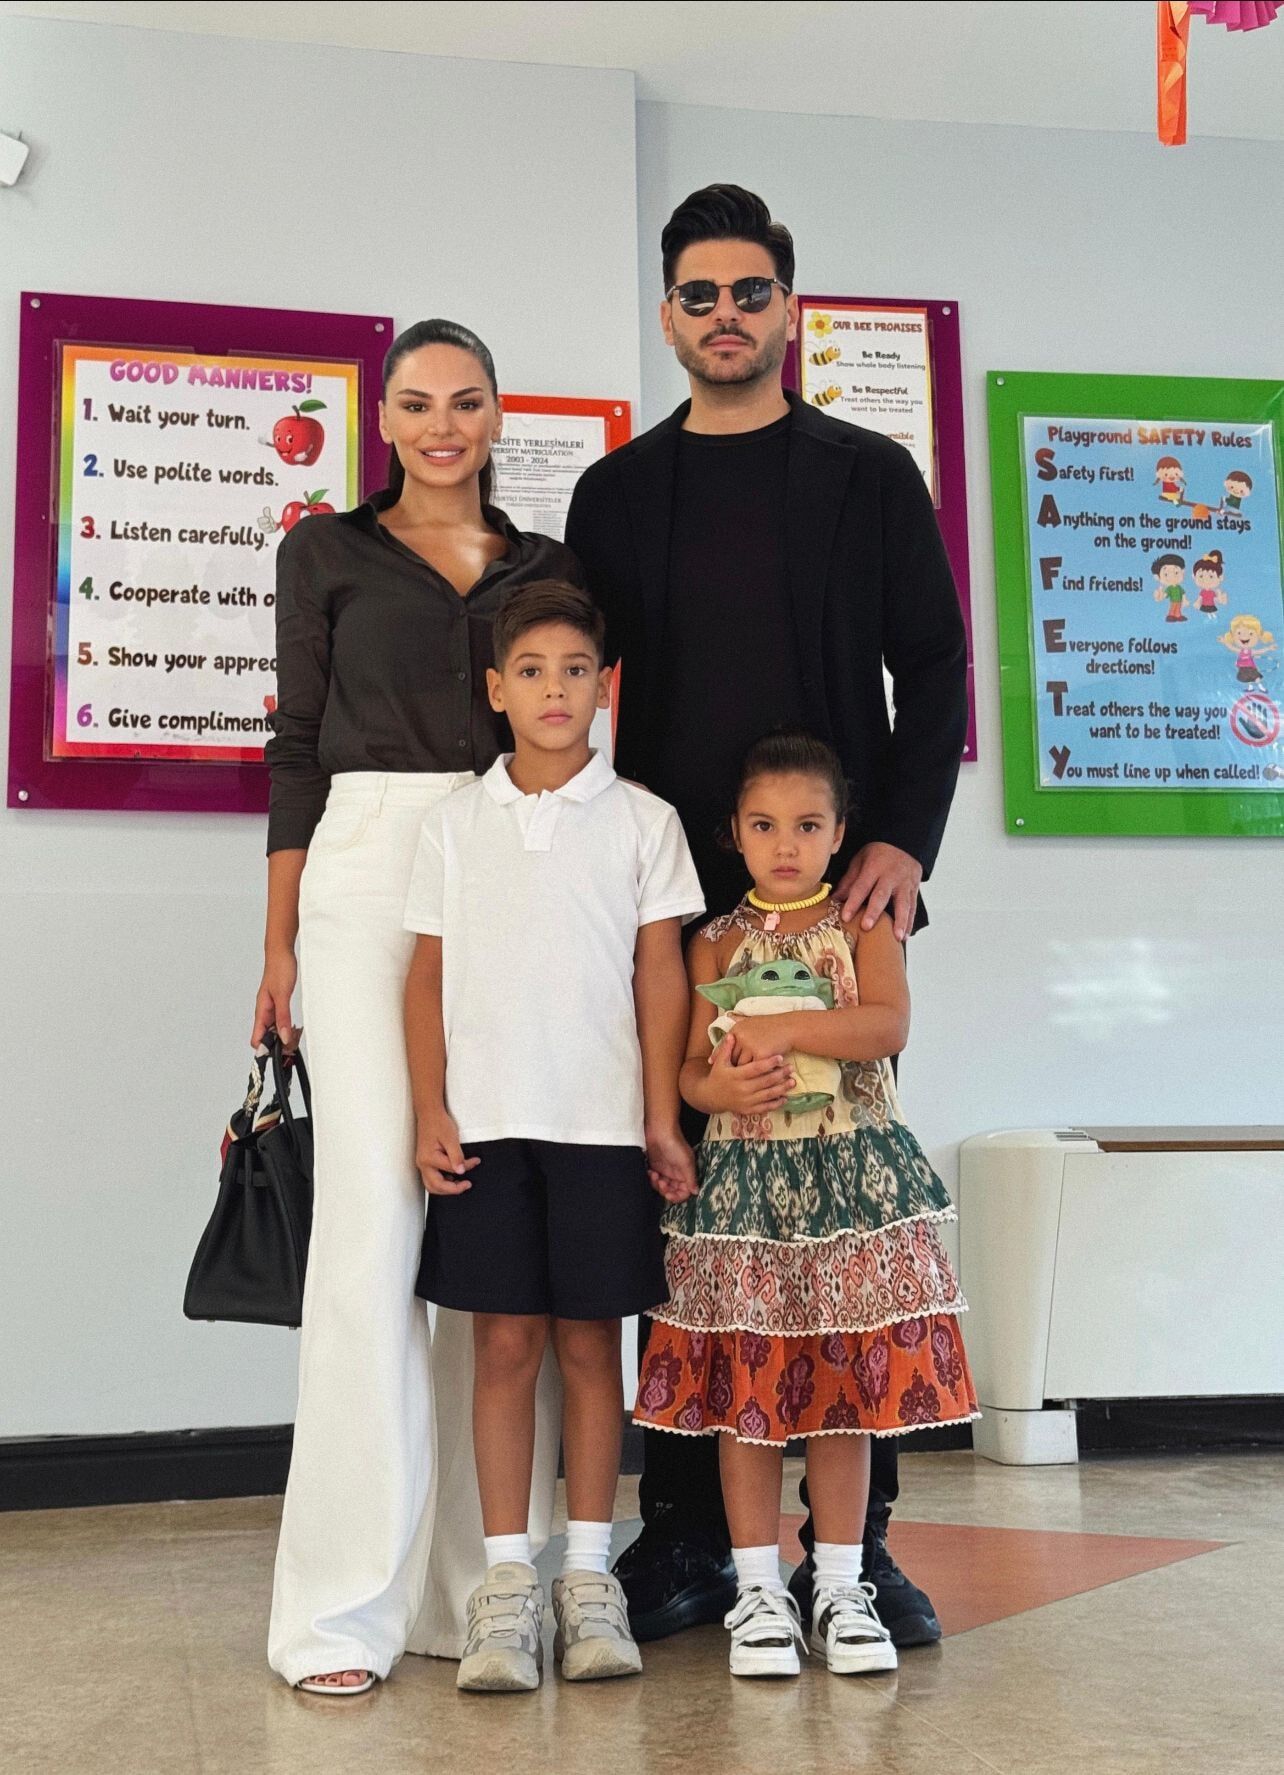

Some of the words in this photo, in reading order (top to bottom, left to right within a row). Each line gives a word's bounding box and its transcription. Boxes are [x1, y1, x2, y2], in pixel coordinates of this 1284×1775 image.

[833, 321, 850, 330] OUR
[854, 322, 871, 331] BEE
[875, 323, 922, 333] PROMISES
[862, 351, 873, 359] Be
[875, 351, 901, 361] Ready
[110, 359, 179, 384] GOOD
[188, 363, 312, 393] MANNERS!
[878, 362, 895, 370] body
[897, 363, 925, 371] listening
[865, 386, 908, 396] Respectful
[895, 398, 908, 406] way
[83, 398, 97, 421] 1.
[108, 403, 151, 424] Wait
[158, 412, 200, 429] your
[207, 408, 250, 430] turn.
[1047, 426, 1132, 447] Playground
[1137, 427, 1205, 446] SAFETY
[1212, 432, 1252, 448] Rules
[83, 454, 104, 477] 2.
[113, 459, 148, 478] Use
[154, 461, 211, 484] polite
[219, 466, 279, 486] words.
[1100, 466, 1134, 481] first!
[80, 516, 101, 539] 3.
[110, 520, 171, 542] Listen
[178, 525, 269, 551] carefully.
[1119, 517, 1135, 528] on
[1139, 514, 1160, 529] the
[1165, 516, 1212, 532] ground
[1216, 516, 1251, 534] stays
[1094, 535, 1111, 548] on
[1115, 533, 1136, 548] the
[1141, 535, 1192, 552] ground!
[78, 576, 100, 600] 4.
[109, 581, 210, 607] Cooperate
[218, 587, 256, 607] with
[1089, 577, 1143, 592] friends!
[1128, 638, 1177, 654] follows
[77, 642, 98, 665] 5.
[108, 647, 157, 668] Show
[165, 653, 207, 673] your
[76, 704, 99, 728] 6.
[108, 708, 151, 729] Give
[1100, 703, 1144, 718] others
[1148, 703, 1170, 718] the
[1175, 706, 1200, 721] way
[1204, 708, 1227, 721] you
[1090, 723, 1121, 738] want
[1126, 724, 1139, 738] to
[1144, 724, 1161, 739] be
[1165, 724, 1220, 740] treated!
[1087, 764, 1119, 779] must
[1123, 764, 1150, 779] line
[1155, 767, 1171, 782] up
[1176, 764, 1210, 780] when
[1214, 763, 1260, 780] called!
